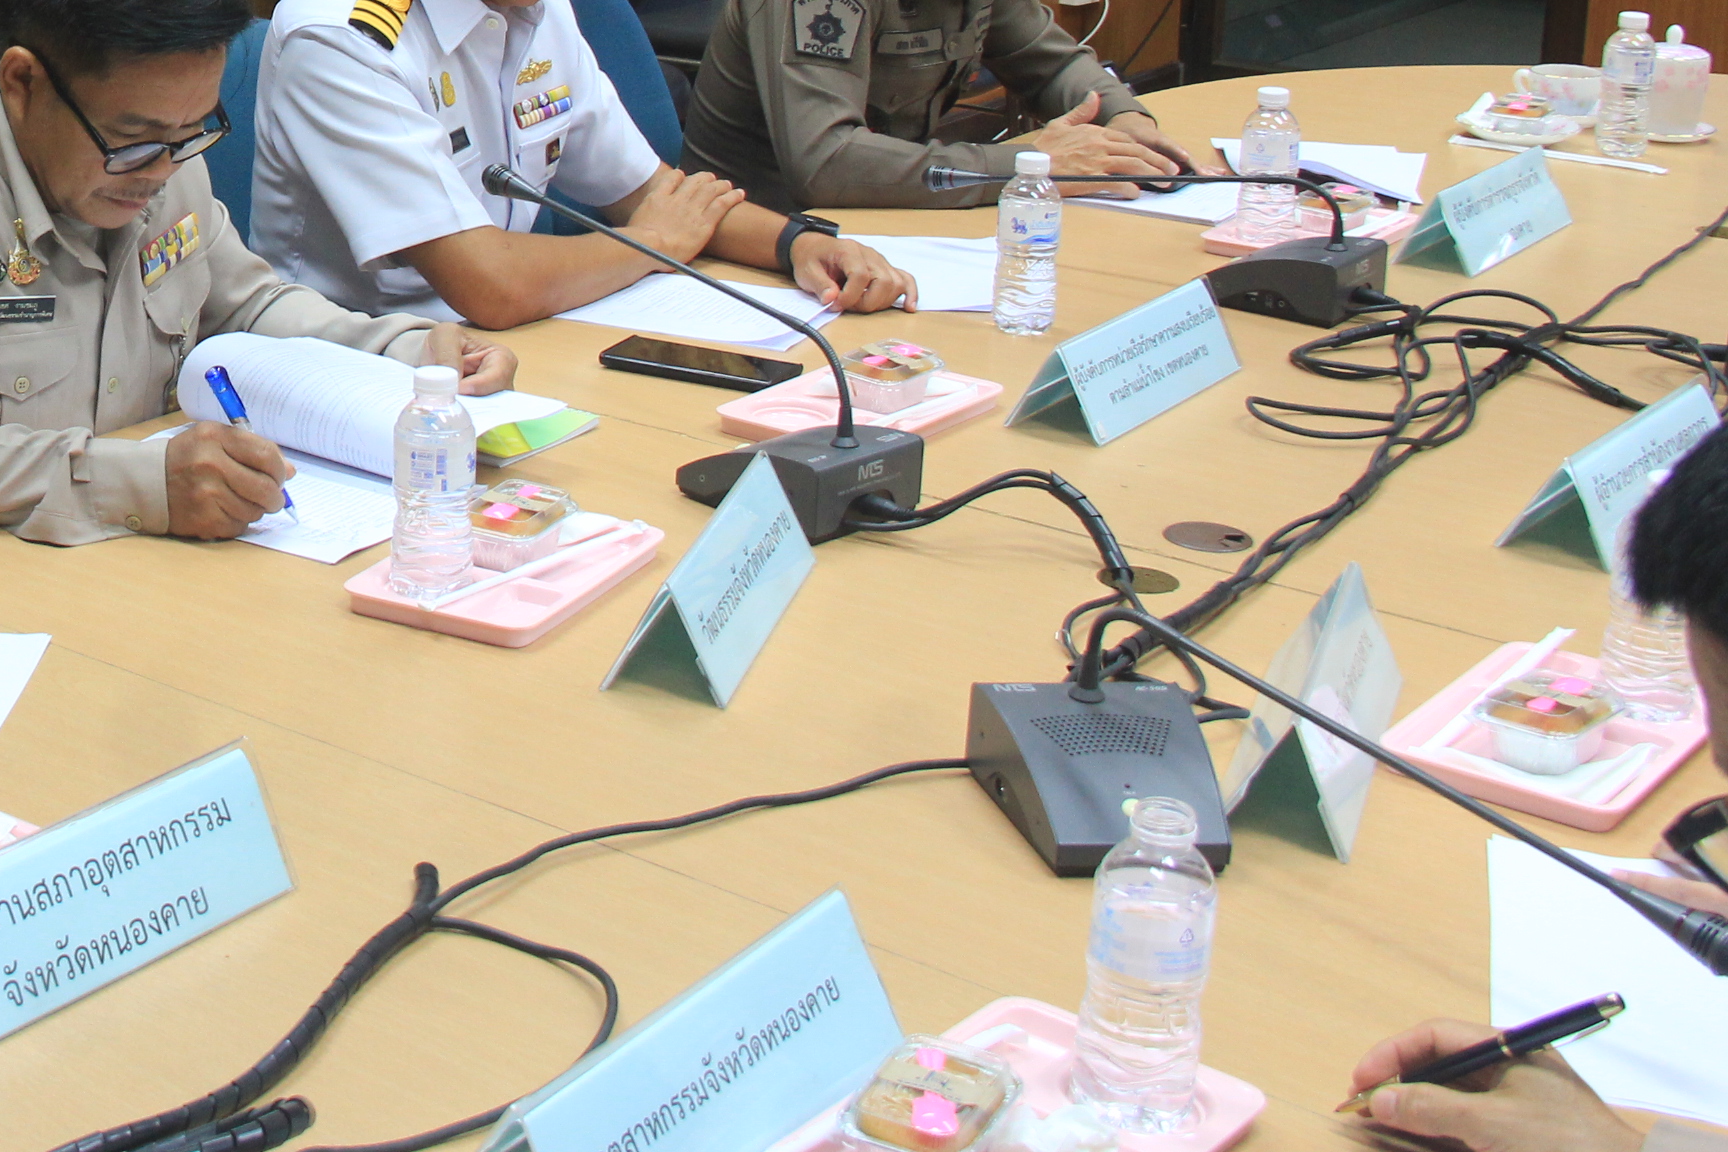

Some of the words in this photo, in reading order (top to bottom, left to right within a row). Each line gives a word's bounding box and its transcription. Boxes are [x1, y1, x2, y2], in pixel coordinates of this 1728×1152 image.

[803, 42, 844, 57] POLICE
[1074, 304, 1216, 392] ผู้บังคับการหน่วยเรือรักษาความสงบเรียบร้อย
[1108, 363, 1165, 404] ตามลำแม่น้ำโขง
[1165, 344, 1210, 375] เขตหนองคาย
[698, 510, 792, 645] วัฒนธรรมจังหวัดหนองคาย
[2, 886, 210, 1007] จังหวัดหนองคาย
